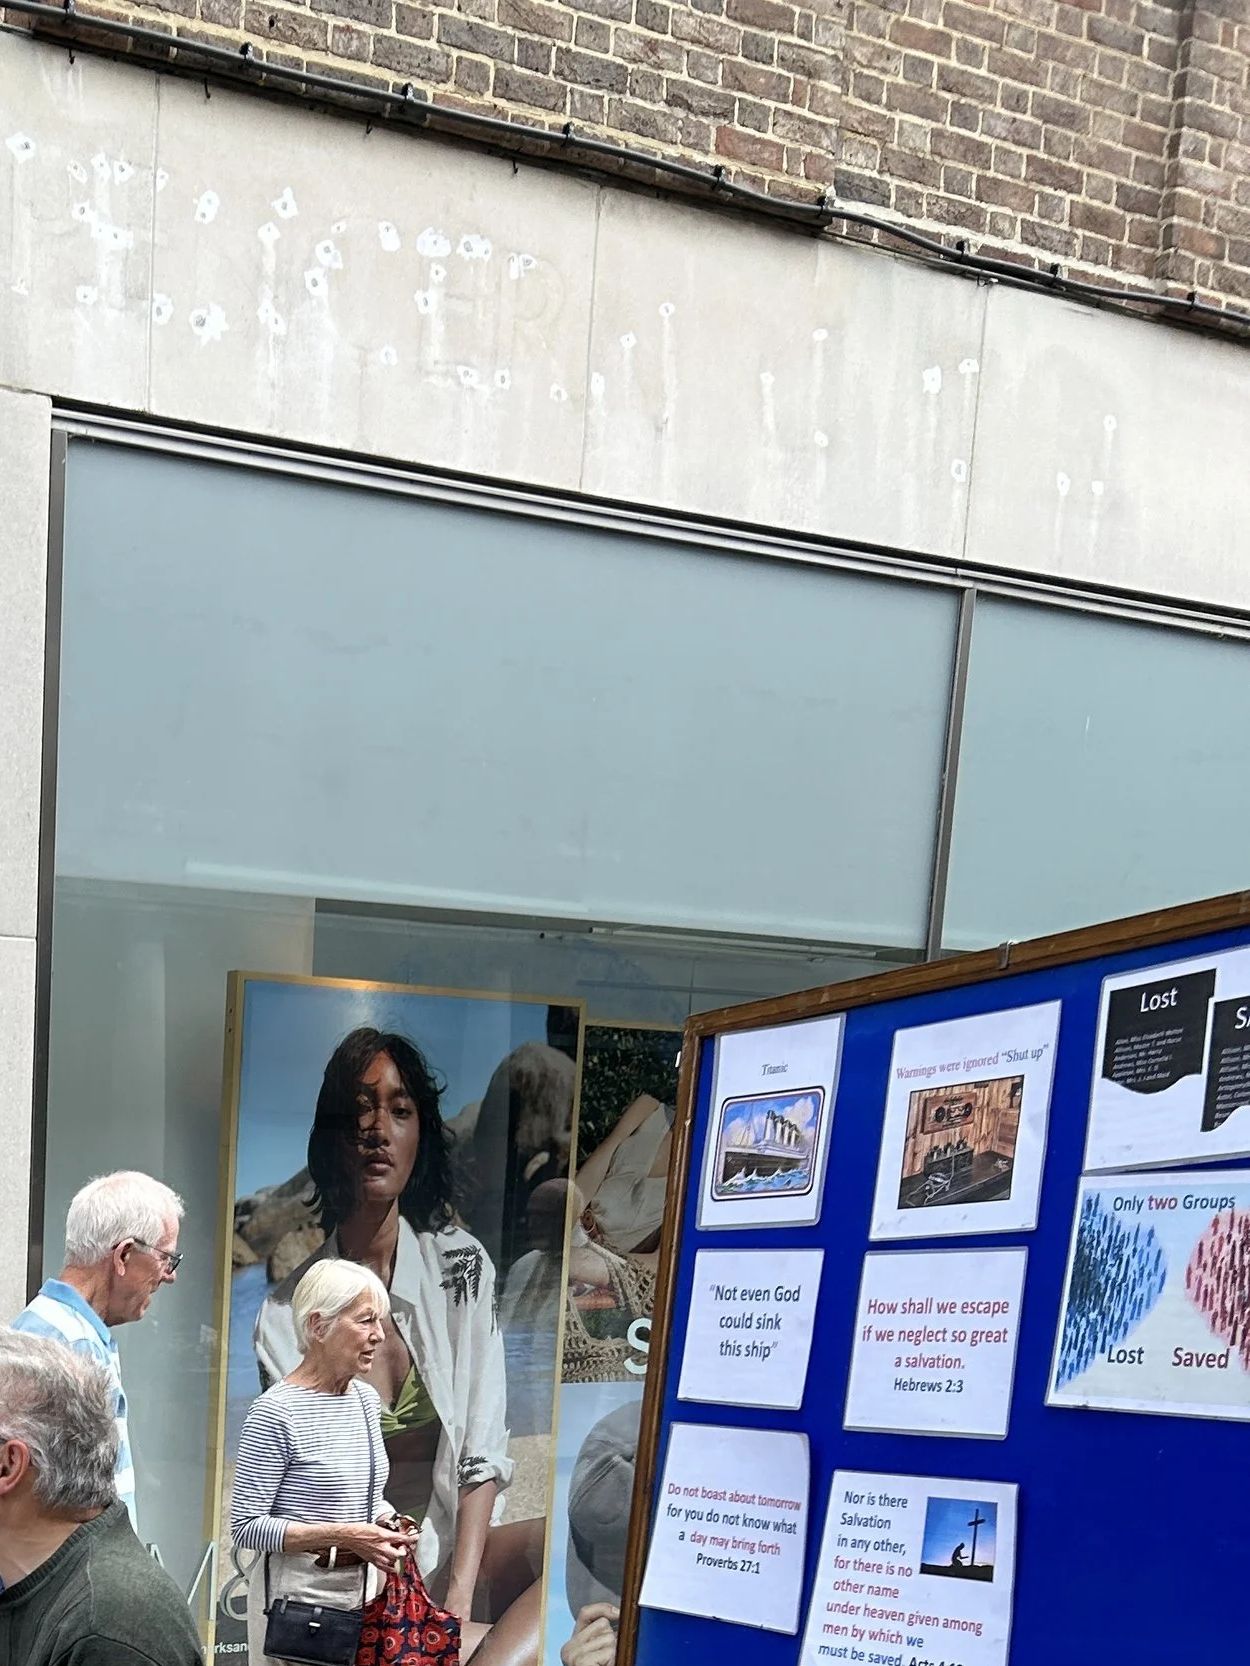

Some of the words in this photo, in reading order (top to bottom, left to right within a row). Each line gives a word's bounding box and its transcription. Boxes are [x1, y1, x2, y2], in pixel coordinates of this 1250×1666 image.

[1140, 987, 1178, 1013] Lost
[761, 1061, 789, 1077] Titanic
[896, 1065, 937, 1081] Warnings
[938, 1060, 961, 1073] were
[962, 1053, 999, 1071] ignored
[1113, 1195, 1144, 1215] Only
[1147, 1195, 1178, 1211] two
[1182, 1193, 1236, 1213] Groups
[739, 1287, 771, 1302] even
[774, 1285, 802, 1303] God
[867, 1298, 898, 1315] How
[900, 1297, 932, 1315] shall
[936, 1301, 958, 1315] we
[960, 1299, 1010, 1319] escape
[719, 1312, 752, 1330] could
[754, 1313, 782, 1331] sink
[862, 1325, 874, 1343] if
[874, 1329, 895, 1343] we
[898, 1326, 947, 1346] neglect
[951, 1329, 967, 1344] so
[969, 1326, 1008, 1347] great
[719, 1340, 742, 1357] this
[1107, 1344, 1145, 1365] Lost
[1171, 1346, 1230, 1369] Saved
[894, 1356, 903, 1369] a
[904, 1352, 966, 1370] salvation.
[894, 1377, 942, 1393] Hebrews
[945, 1378, 964, 1394] 2:3
[668, 1483, 681, 1495] Do
[683, 1485, 699, 1497] not
[701, 1486, 727, 1501] boast
[728, 1489, 756, 1505] about
[757, 1494, 802, 1511] tomorrow
[844, 1490, 866, 1506] Nor
[867, 1492, 876, 1506] is
[878, 1493, 908, 1509] there
[667, 1503, 682, 1518] for
[684, 1509, 704, 1522] you
[706, 1509, 720, 1523] do
[722, 1513, 740, 1526] not
[742, 1513, 771, 1530] know
[773, 1518, 797, 1535] what
[840, 1512, 892, 1530] Salvation
[678, 1530, 685, 1541] a
[690, 1530, 708, 1547] day
[709, 1536, 728, 1550] may
[731, 1536, 756, 1554] bring
[758, 1540, 781, 1555] forth
[837, 1534, 849, 1548] in
[850, 1538, 872, 1552] any
[873, 1539, 907, 1556] other,
[696, 1552, 738, 1571] Proverbs
[739, 1559, 760, 1574] 27:1
[833, 1555, 851, 1569] for
[852, 1558, 883, 1575] there
[885, 1562, 895, 1575] is
[897, 1564, 913, 1577] no
[833, 1579, 864, 1594] other
[866, 1583, 900, 1598] name
[826, 1601, 861, 1616] under
[863, 1603, 905, 1622] heaven
[907, 1611, 939, 1627] given
[942, 1618, 983, 1636] among
[822, 1623, 848, 1637] men
[851, 1624, 866, 1642] by
[868, 1627, 903, 1644] which
[906, 1636, 924, 1648] we
[818, 1644, 848, 1659] must
[850, 1647, 866, 1661] be
